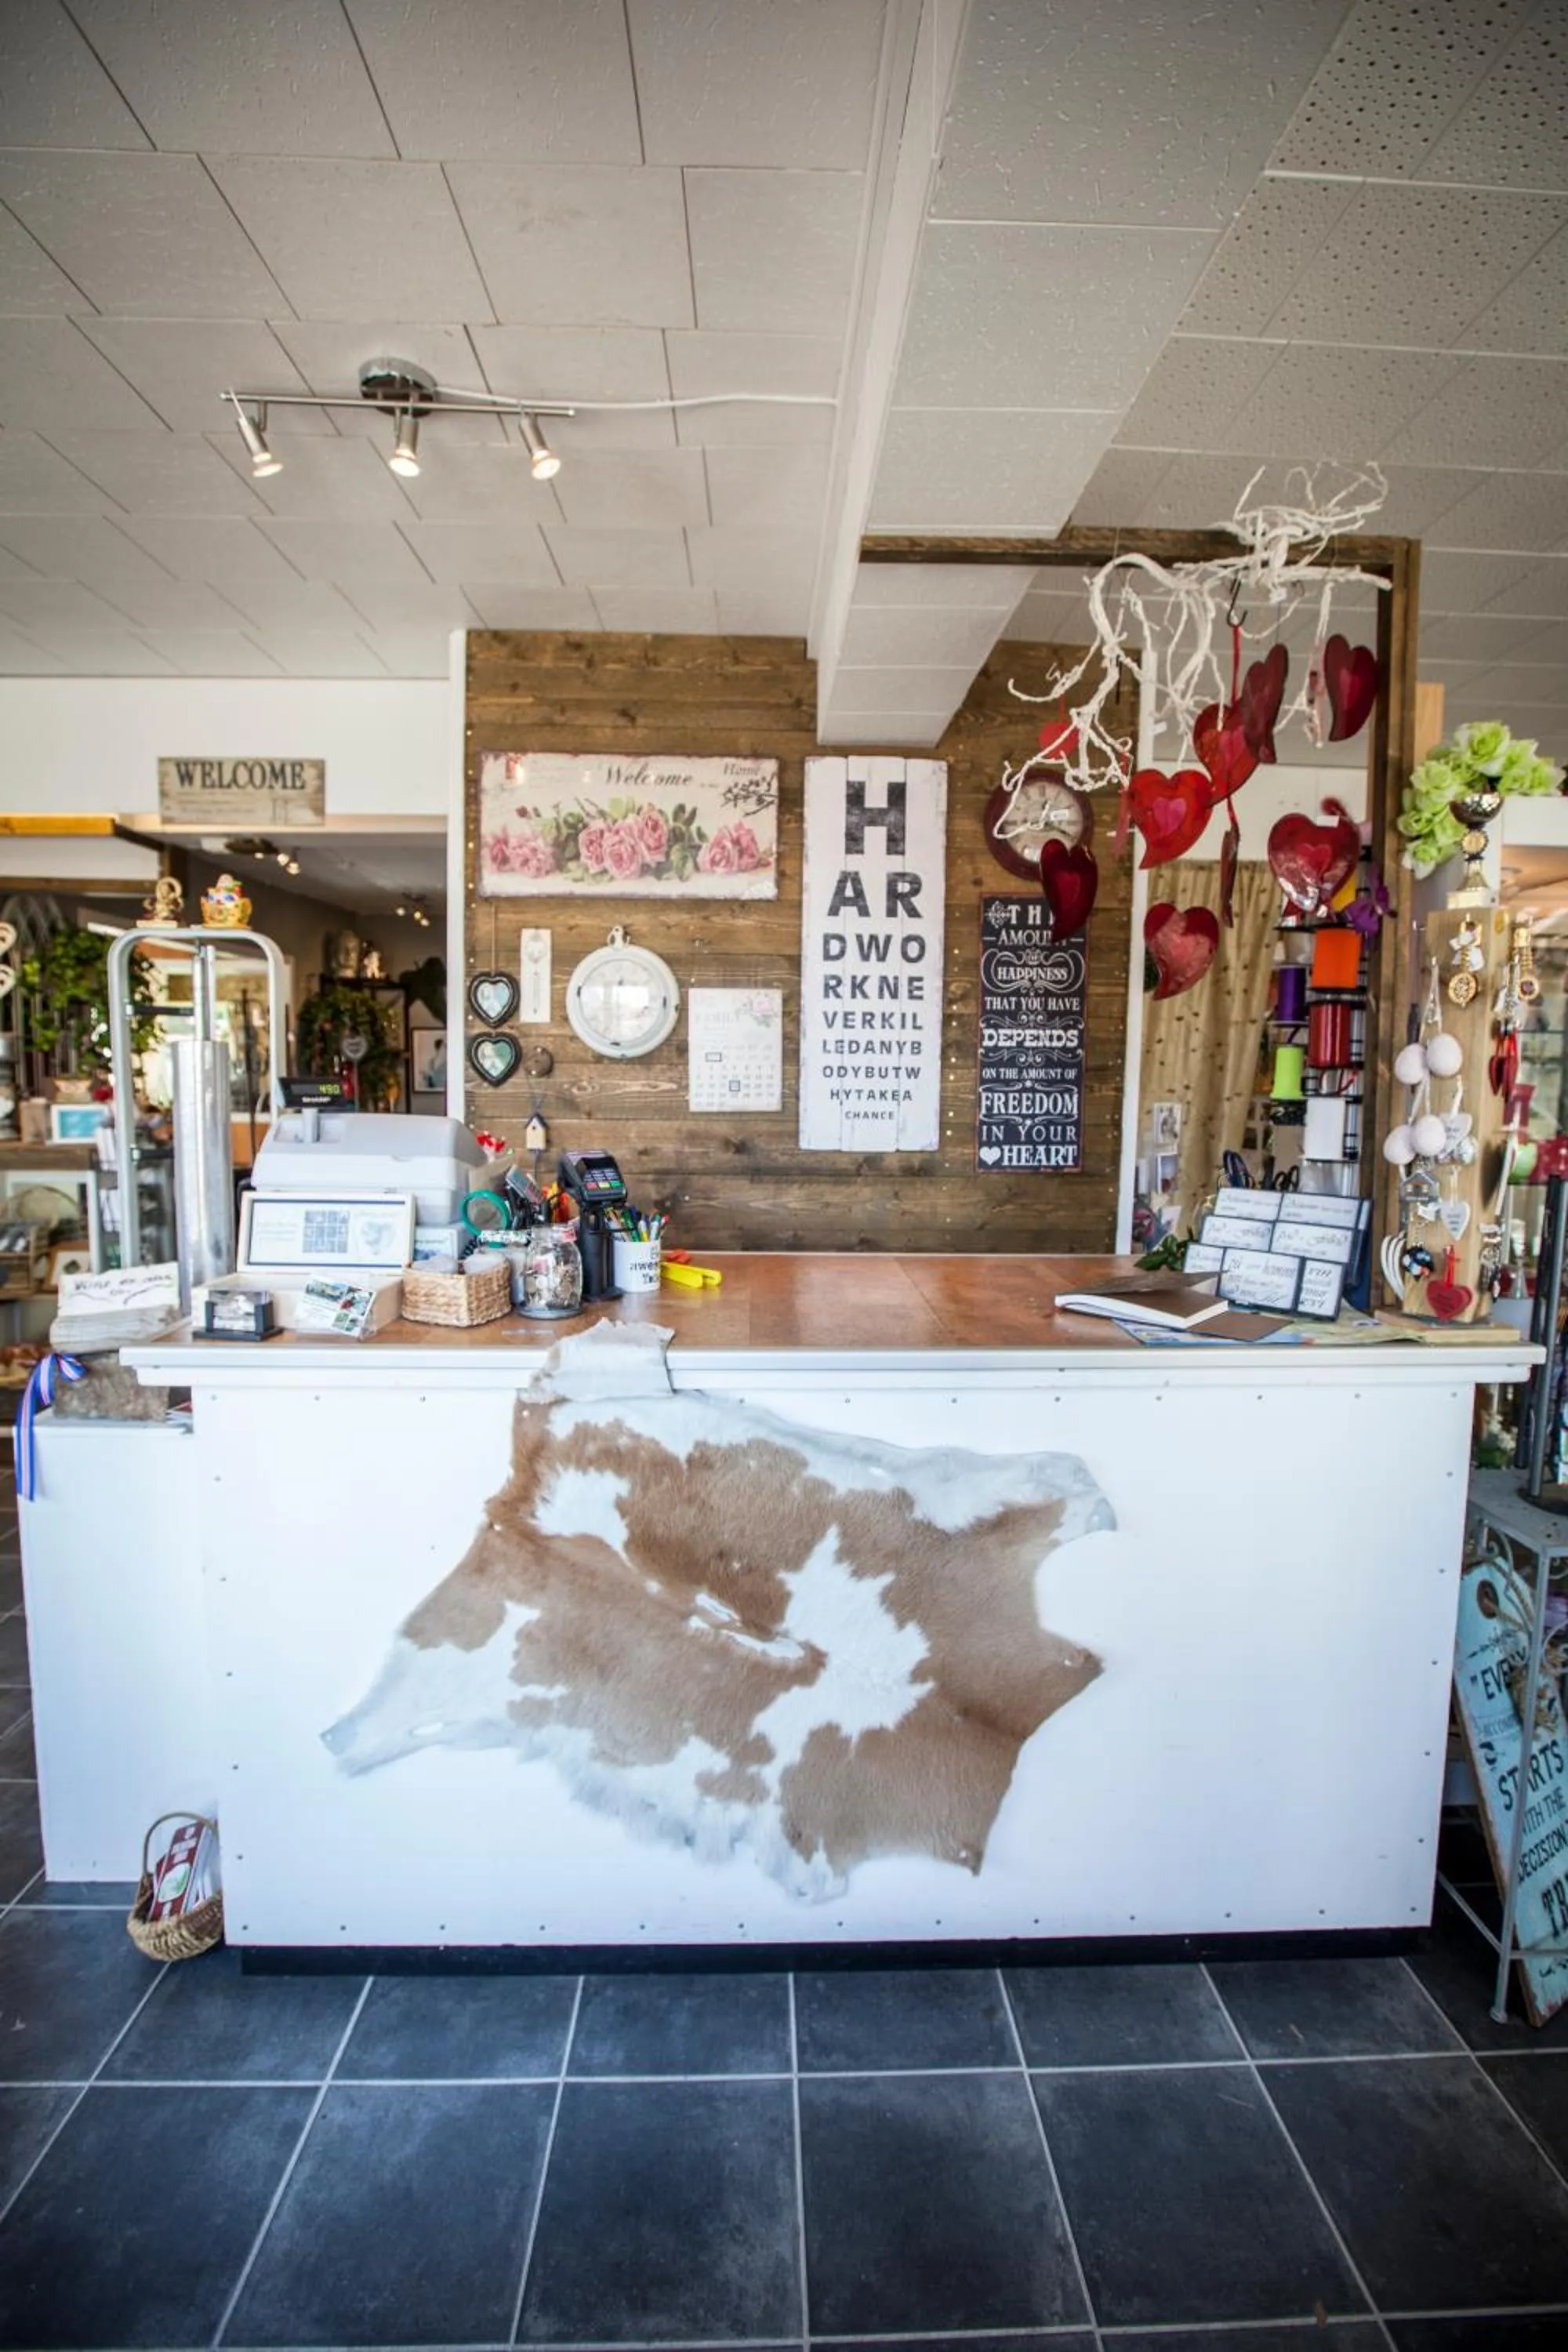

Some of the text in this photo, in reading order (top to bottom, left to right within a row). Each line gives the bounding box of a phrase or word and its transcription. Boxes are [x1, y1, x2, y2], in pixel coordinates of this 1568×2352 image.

[175, 760, 306, 789] WELCOME
[605, 762, 694, 785] Welcome
[845, 781, 906, 855] H
[823, 933, 926, 964] DWO
[997, 966, 1069, 981] HAPPINESS
[823, 975, 924, 1000] RKNE
[985, 996, 1080, 1011] THAT YOU HAVE
[822, 1011, 924, 1030] VERKIL
[982, 1029, 1080, 1047] DEPENDS
[822, 1040, 922, 1055] LEDANYB
[822, 1065, 921, 1080] ODYBUTW
[982, 1068, 1079, 1080] ON THE AMOUNT OF
[830, 1089, 913, 1102] HYTAKEA
[981, 1092, 1079, 1116] FREEDOM
[845, 1111, 895, 1120] CHANCE
[982, 1124, 1078, 1142] IN YOUR
[1001, 1145, 1079, 1167] HEART
[1542, 1785, 1566, 1819] THE
